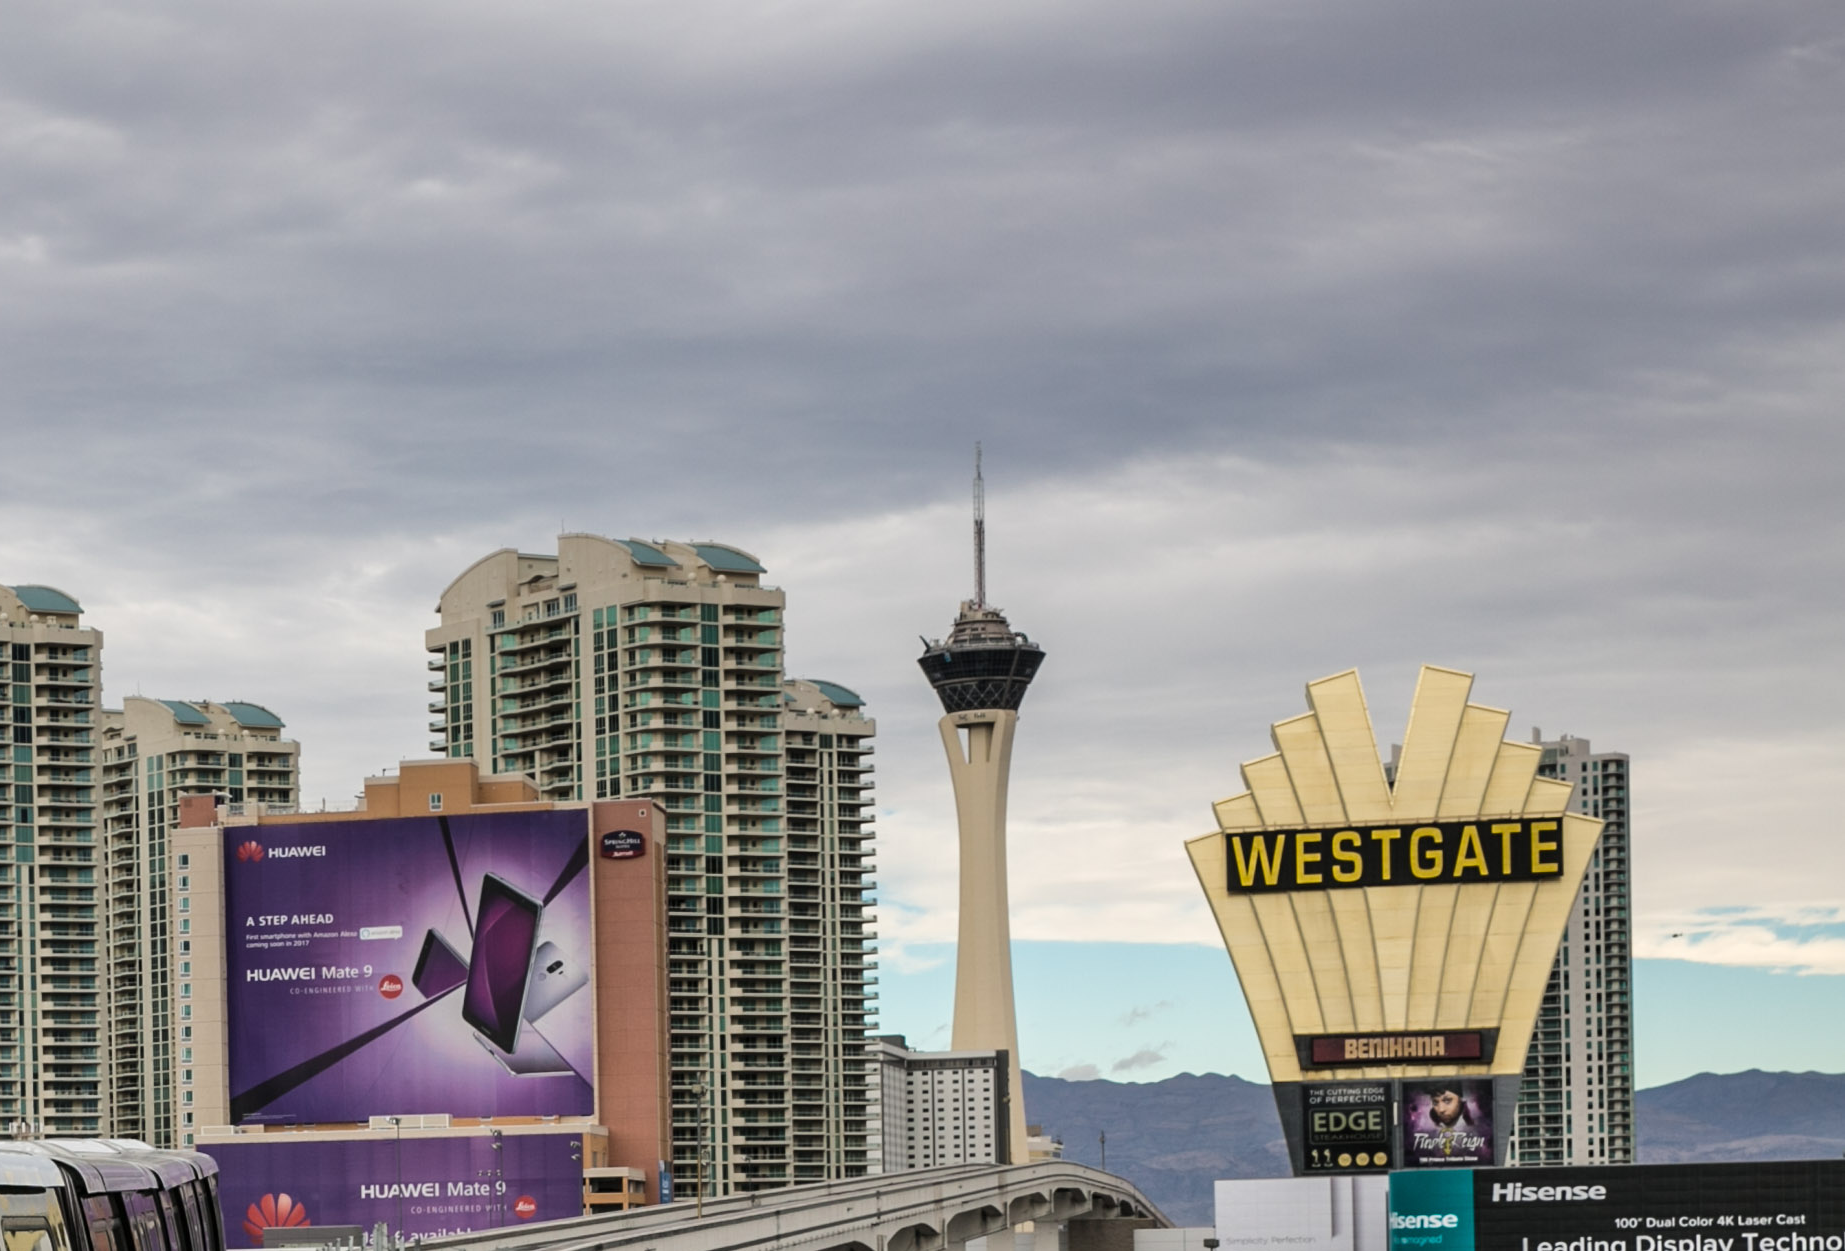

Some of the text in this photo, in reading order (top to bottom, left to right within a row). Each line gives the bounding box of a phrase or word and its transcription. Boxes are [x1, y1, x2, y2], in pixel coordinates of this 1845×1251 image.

[268, 845, 326, 858] HUAWEI
[1232, 821, 1560, 887] WESTGATE
[246, 914, 334, 926] A STEP AHEAD
[260, 933, 296, 941] smartphone
[246, 965, 373, 982] HUAWEI Mate 9
[290, 986, 351, 995] CO-ENGINEERED
[1344, 1036, 1446, 1059] BENIHANA
[1309, 1095, 1385, 1104] OF PERFECTION
[1313, 1111, 1382, 1133] EDGE
[1314, 1133, 1383, 1142] STEAKHOUSE
[361, 1180, 506, 1199] HUAWEI Mate 9
[1492, 1182, 1607, 1202] Hisense
[410, 1205, 481, 1215] CO-ENGINEERED
[1646, 1217, 1675, 1228] Dual
[1678, 1216, 1714, 1227] Color
[1717, 1215, 1734, 1226] 4K
[1738, 1215, 1773, 1226] Laser
[1776, 1214, 1806, 1225] Cast
[1271, 1236, 1316, 1245] Perfection
